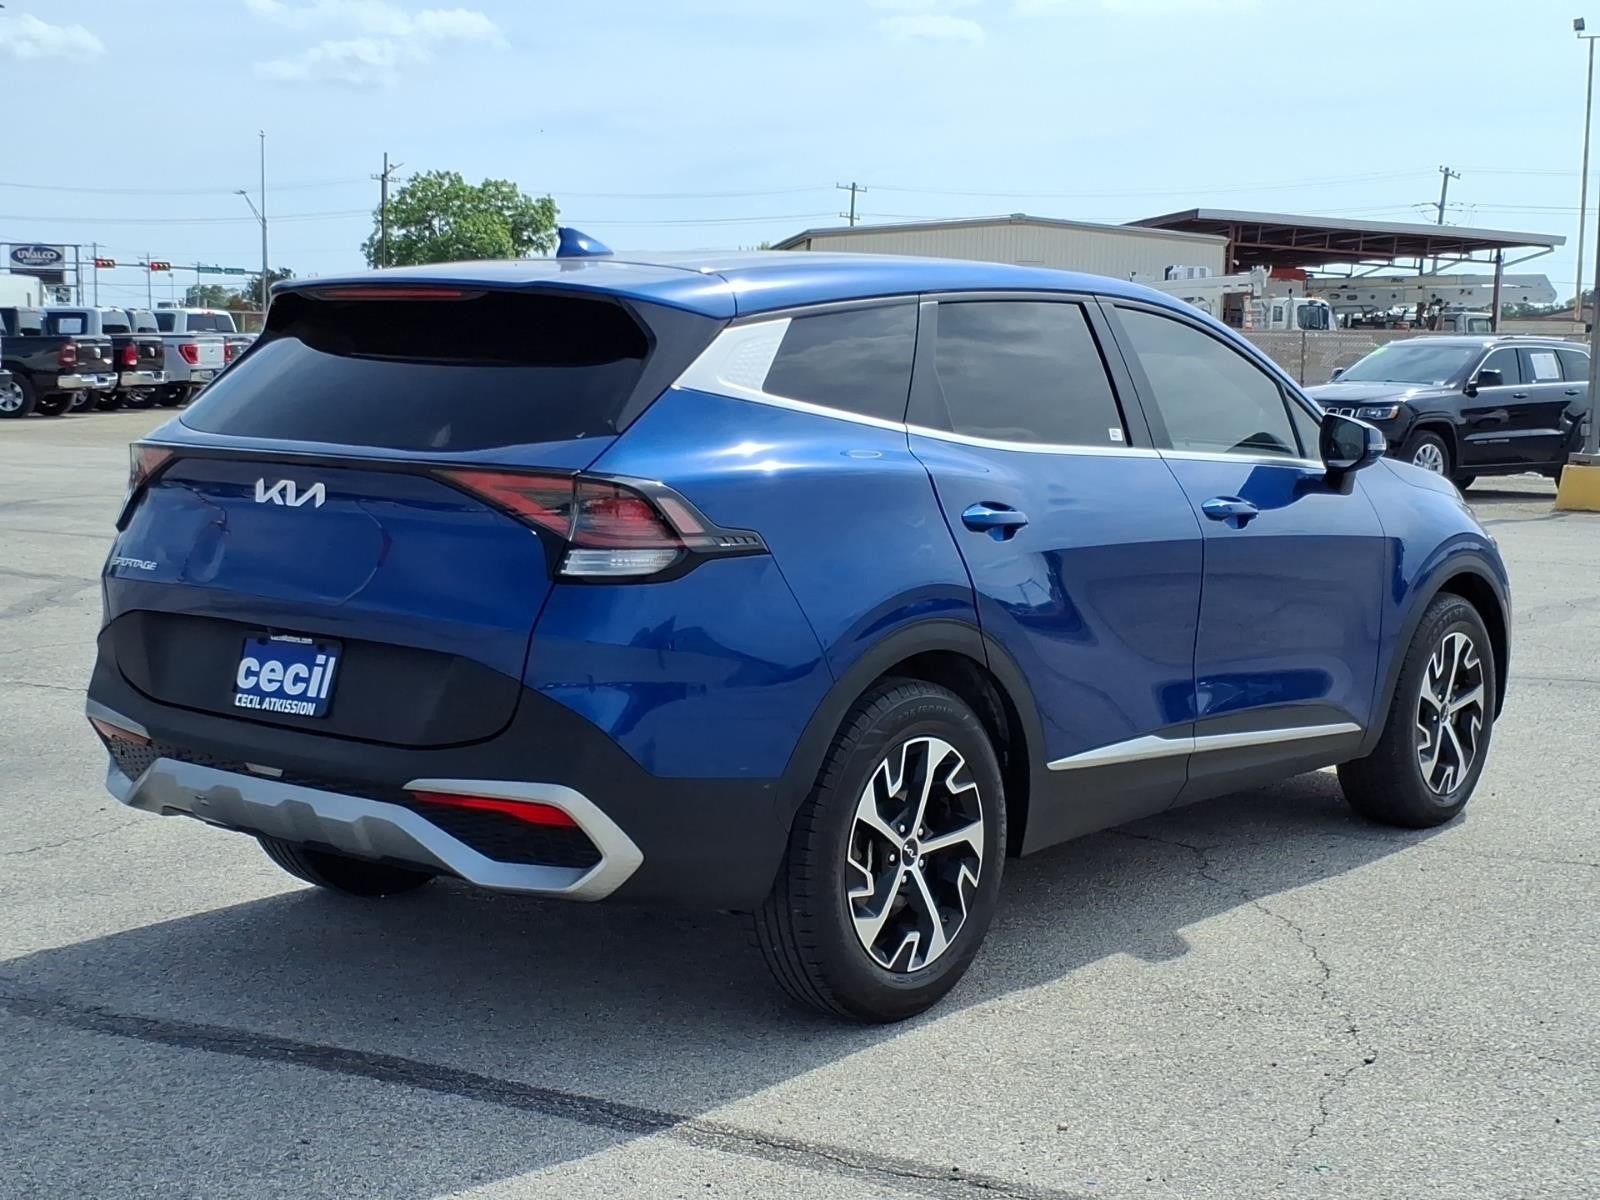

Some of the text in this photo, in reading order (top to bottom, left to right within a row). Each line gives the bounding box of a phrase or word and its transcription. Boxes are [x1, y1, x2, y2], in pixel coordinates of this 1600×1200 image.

[254, 477, 326, 508] KIA
[112, 556, 158, 571] SPORTAGE
[236, 654, 336, 699] cecil
[234, 693, 316, 716] CECIL ATKISSION
